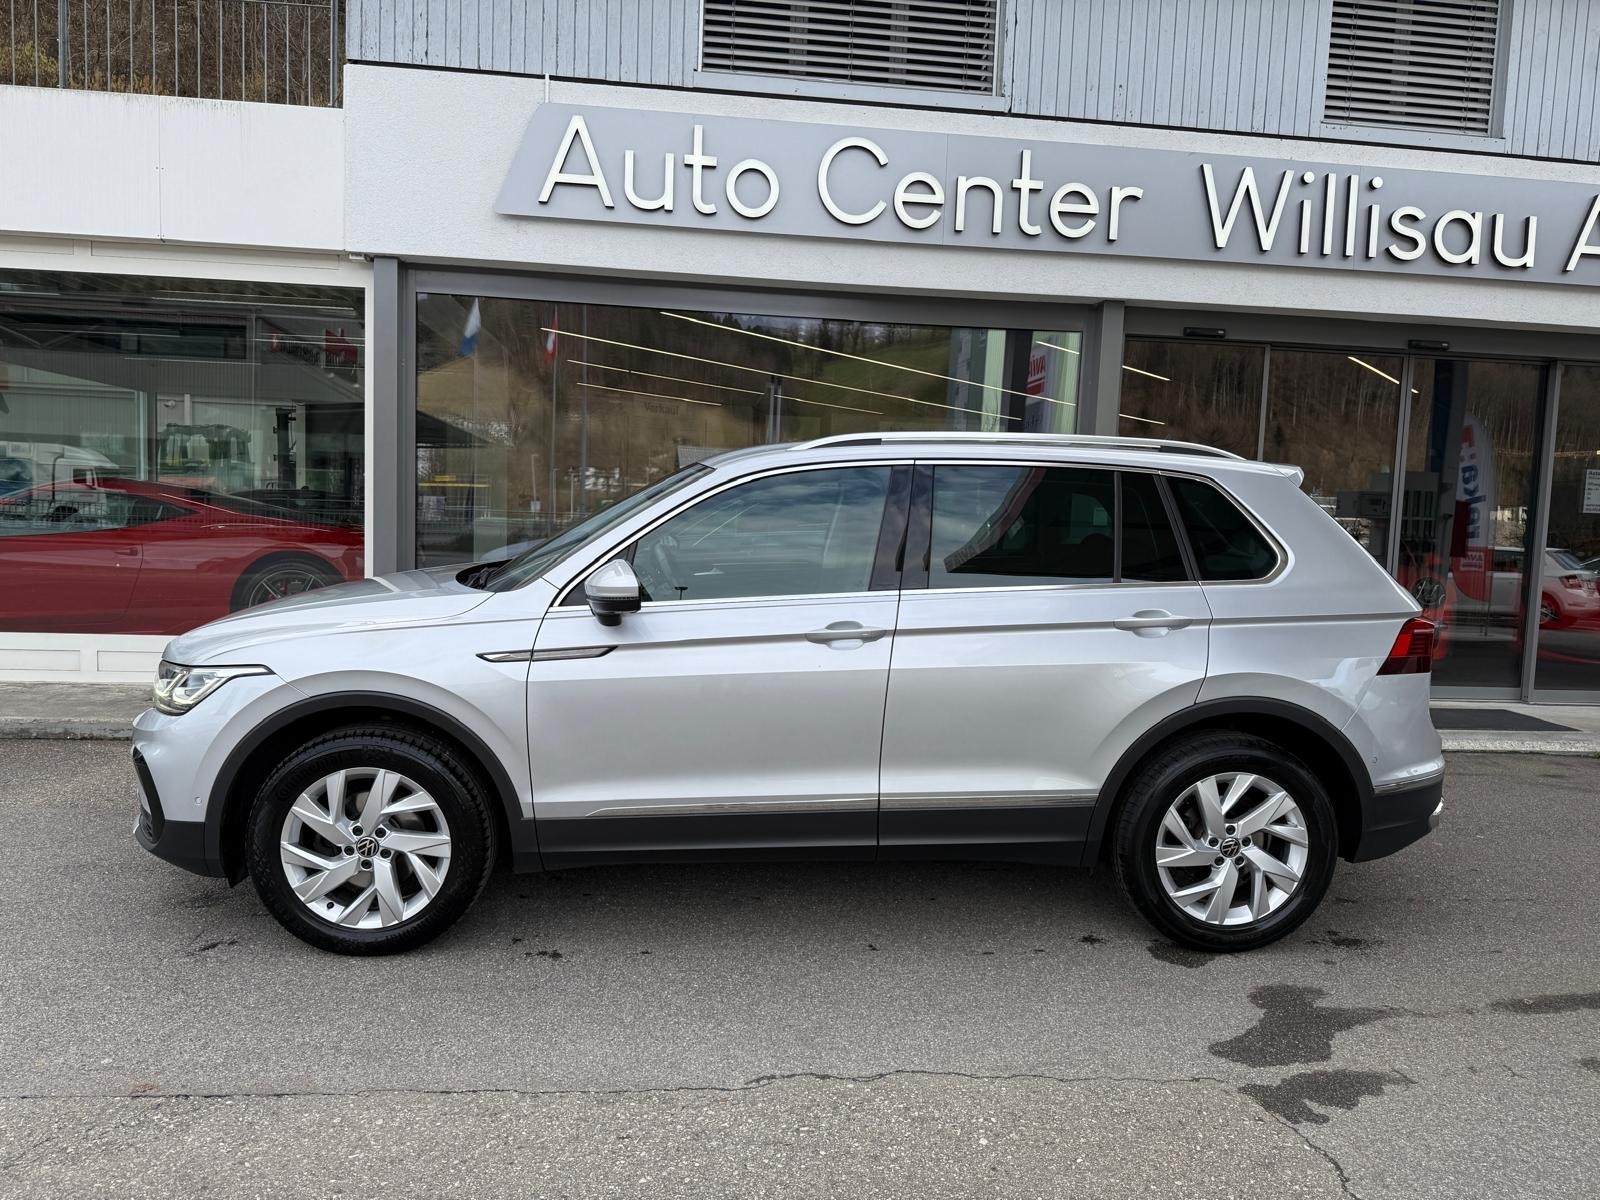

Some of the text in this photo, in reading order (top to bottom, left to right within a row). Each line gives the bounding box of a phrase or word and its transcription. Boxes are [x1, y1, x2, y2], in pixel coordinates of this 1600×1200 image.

[537, 114, 780, 219] Auto
[816, 136, 1144, 242] Center
[1200, 163, 1538, 268] Willisau
